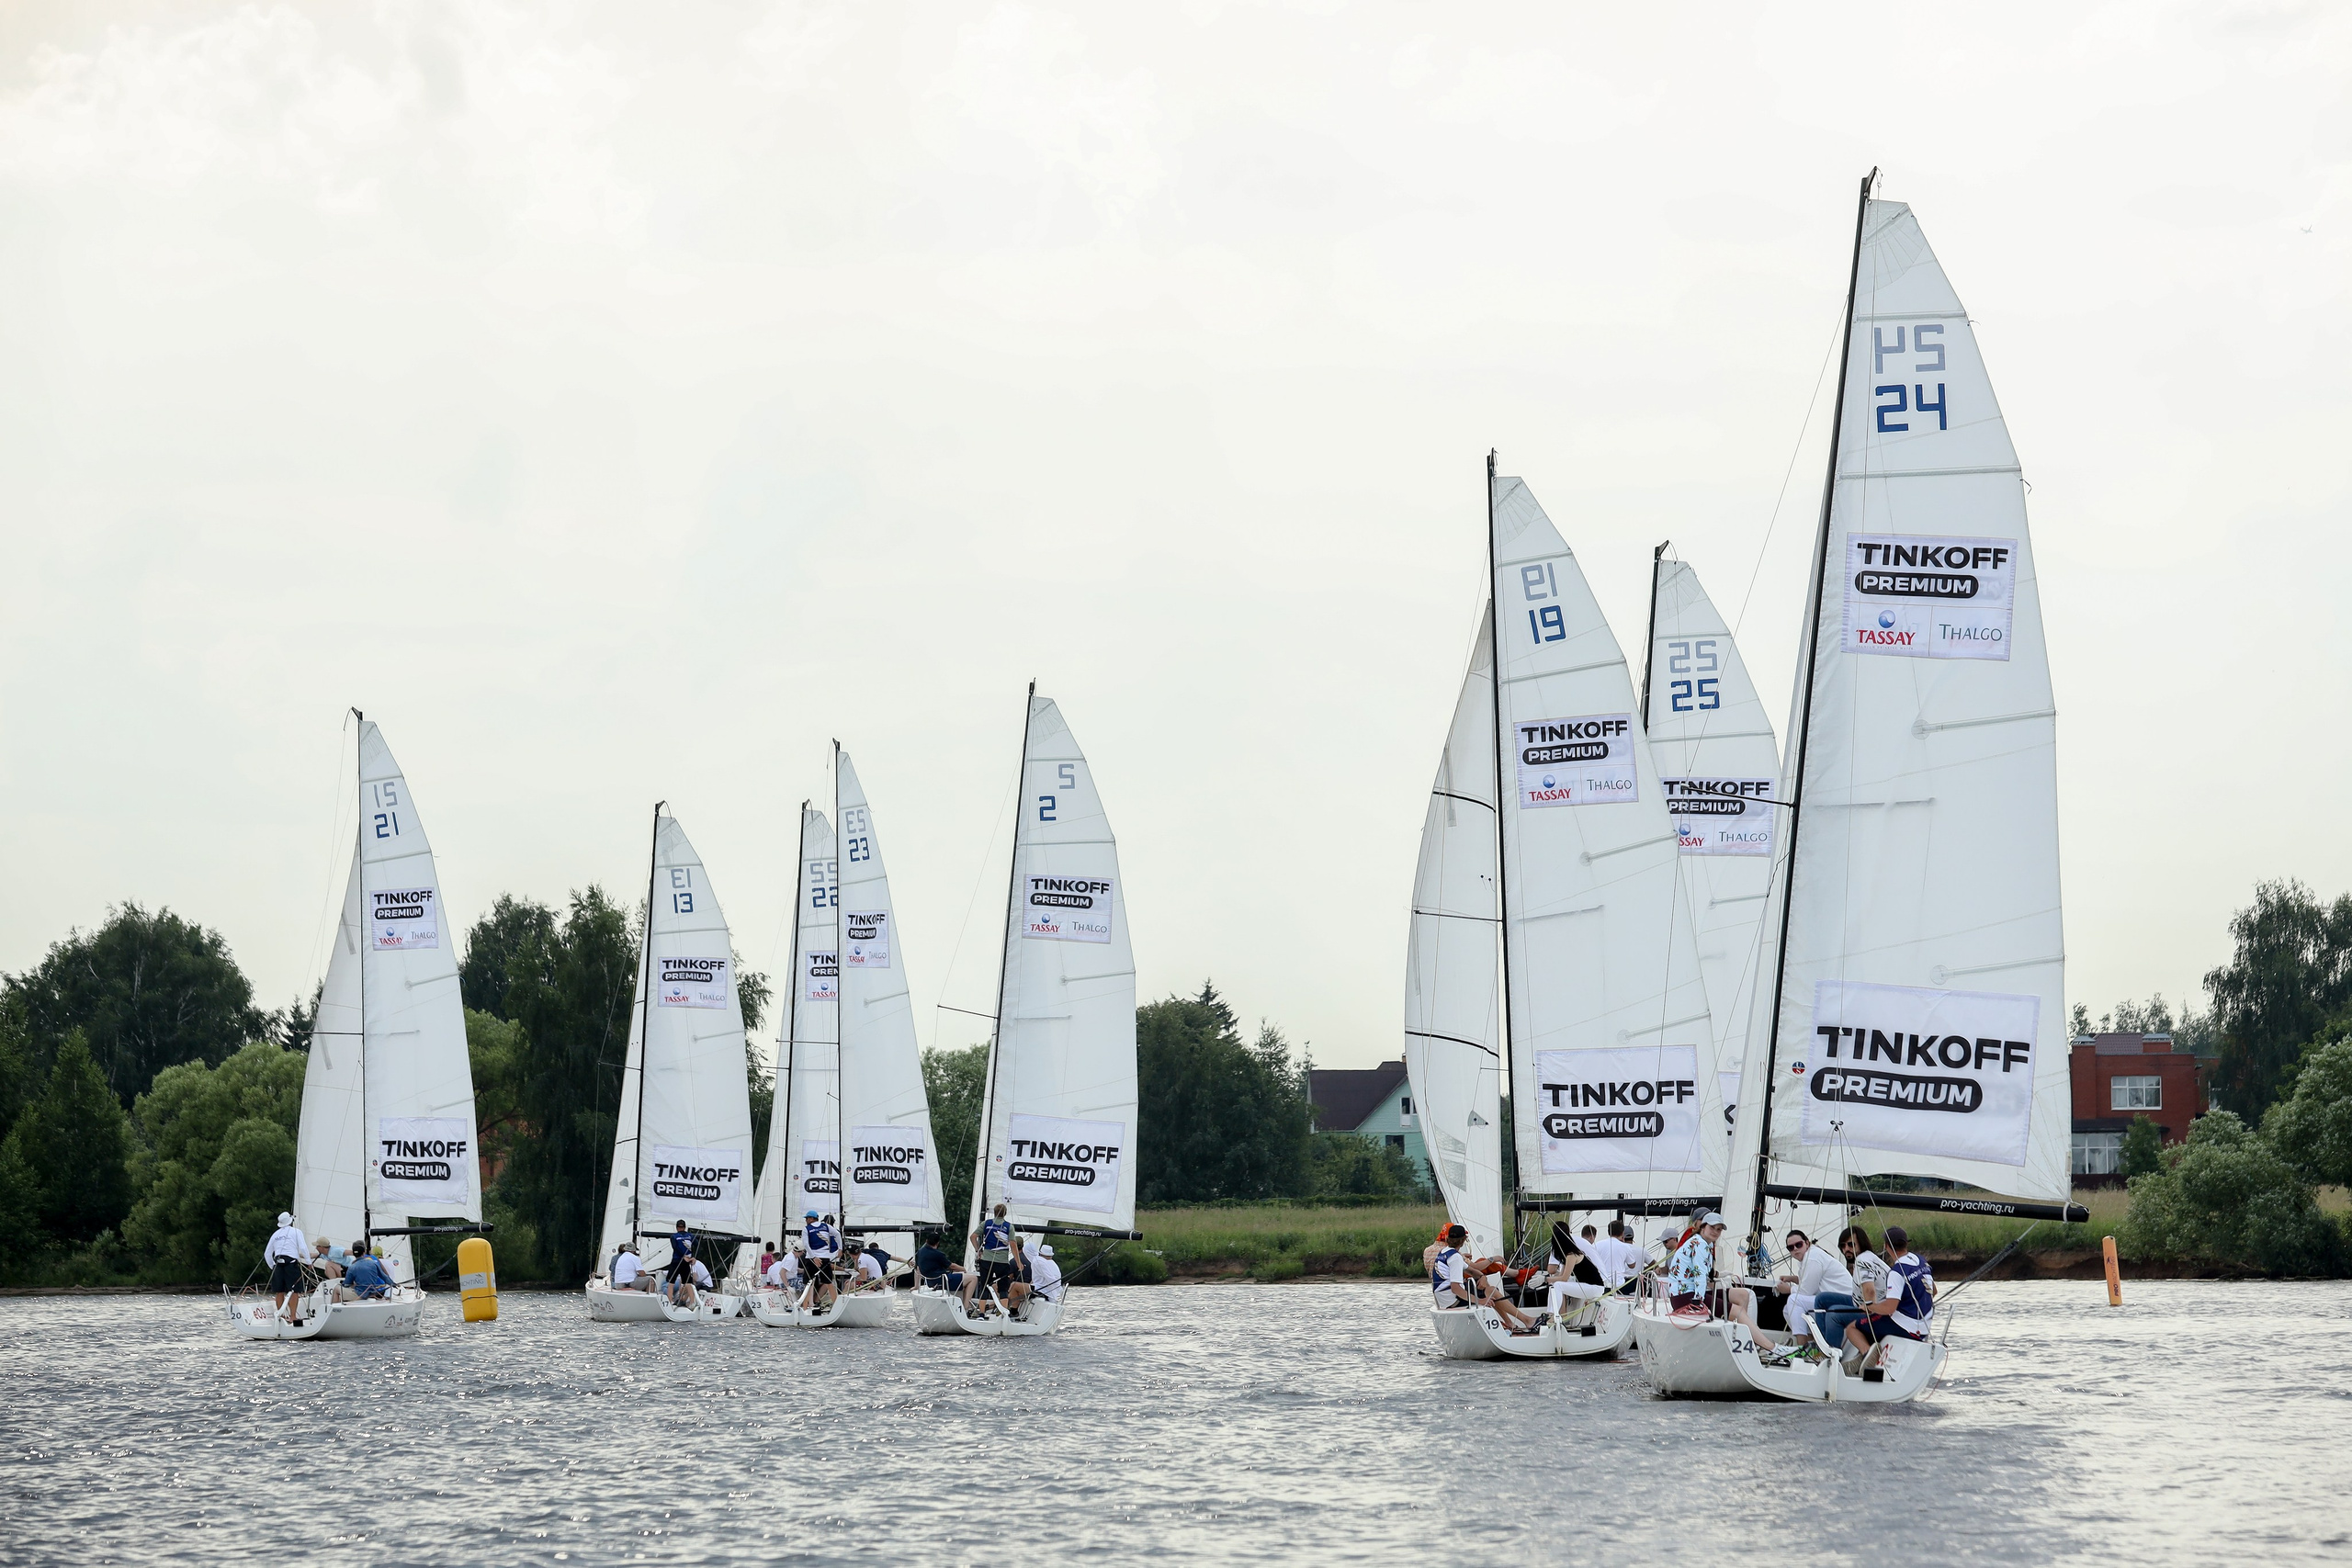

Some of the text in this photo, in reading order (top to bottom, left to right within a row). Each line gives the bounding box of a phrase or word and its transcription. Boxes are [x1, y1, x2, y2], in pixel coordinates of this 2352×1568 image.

[1874, 383, 1947, 434] 24
[1857, 542, 2008, 570] TINKOFF
[1862, 574, 1972, 594] PREMIUM
[1528, 604, 1566, 645] 19
[1856, 629, 1917, 646] TASSAY
[1939, 623, 2003, 642] THALGO
[1670, 678, 1720, 712] 25
[1521, 720, 1628, 744] TINKOFF
[1528, 744, 1604, 762] PREMIUM
[1587, 778, 1633, 792] THALGO
[1664, 781, 1770, 795] TINKOFF
[1528, 788, 1571, 801] TASSAY
[1038, 795, 1057, 821] 2
[1669, 801, 1740, 812] PREMIUM
[374, 811, 399, 839] 21
[1679, 837, 1704, 847] SSAY
[1719, 831, 1768, 842] THALGO
[848, 837, 870, 863] 23
[1031, 878, 1110, 895] TINKOFF
[373, 890, 433, 905] TINKOFF
[673, 892, 694, 914] 13
[1034, 895, 1090, 907] PREMIUM
[377, 907, 422, 918] PREMIUM
[848, 914, 886, 925] TINKOFF
[1030, 923, 1061, 933] TASSAY
[1071, 921, 1107, 933] THALGO
[662, 959, 725, 971] TINKOFF
[664, 972, 710, 981] PREMIUM
[698, 992, 725, 1001] THALGO
[1816, 1026, 2030, 1073] TINKOFF
[1543, 1080, 1694, 1107] TINKOFF
[1821, 1074, 1973, 1107] PREMIUM
[1551, 1117, 1657, 1134] PREMIUM
[381, 1140, 467, 1157] TINKOFF
[853, 1146, 924, 1164] TINKOFF
[1011, 1139, 1119, 1164] TINKOFF
[386, 1164, 447, 1177] PREMIUM
[654, 1163, 740, 1182] TINKOFF
[856, 1169, 909, 1181] PREMIUM
[1012, 1165, 1091, 1182] PREMIUM
[657, 1184, 718, 1198] PREMIUM
[1645, 1198, 1698, 1207] pro-yachting.ru
[1939, 1199, 2015, 1214] pro-yachting.ru
[1064, 1228, 1102, 1237] pro-yachting.ru
[231, 1312, 242, 1320] 20
[1485, 1319, 1499, 1330] 19
[1732, 1339, 1754, 1354] 24
